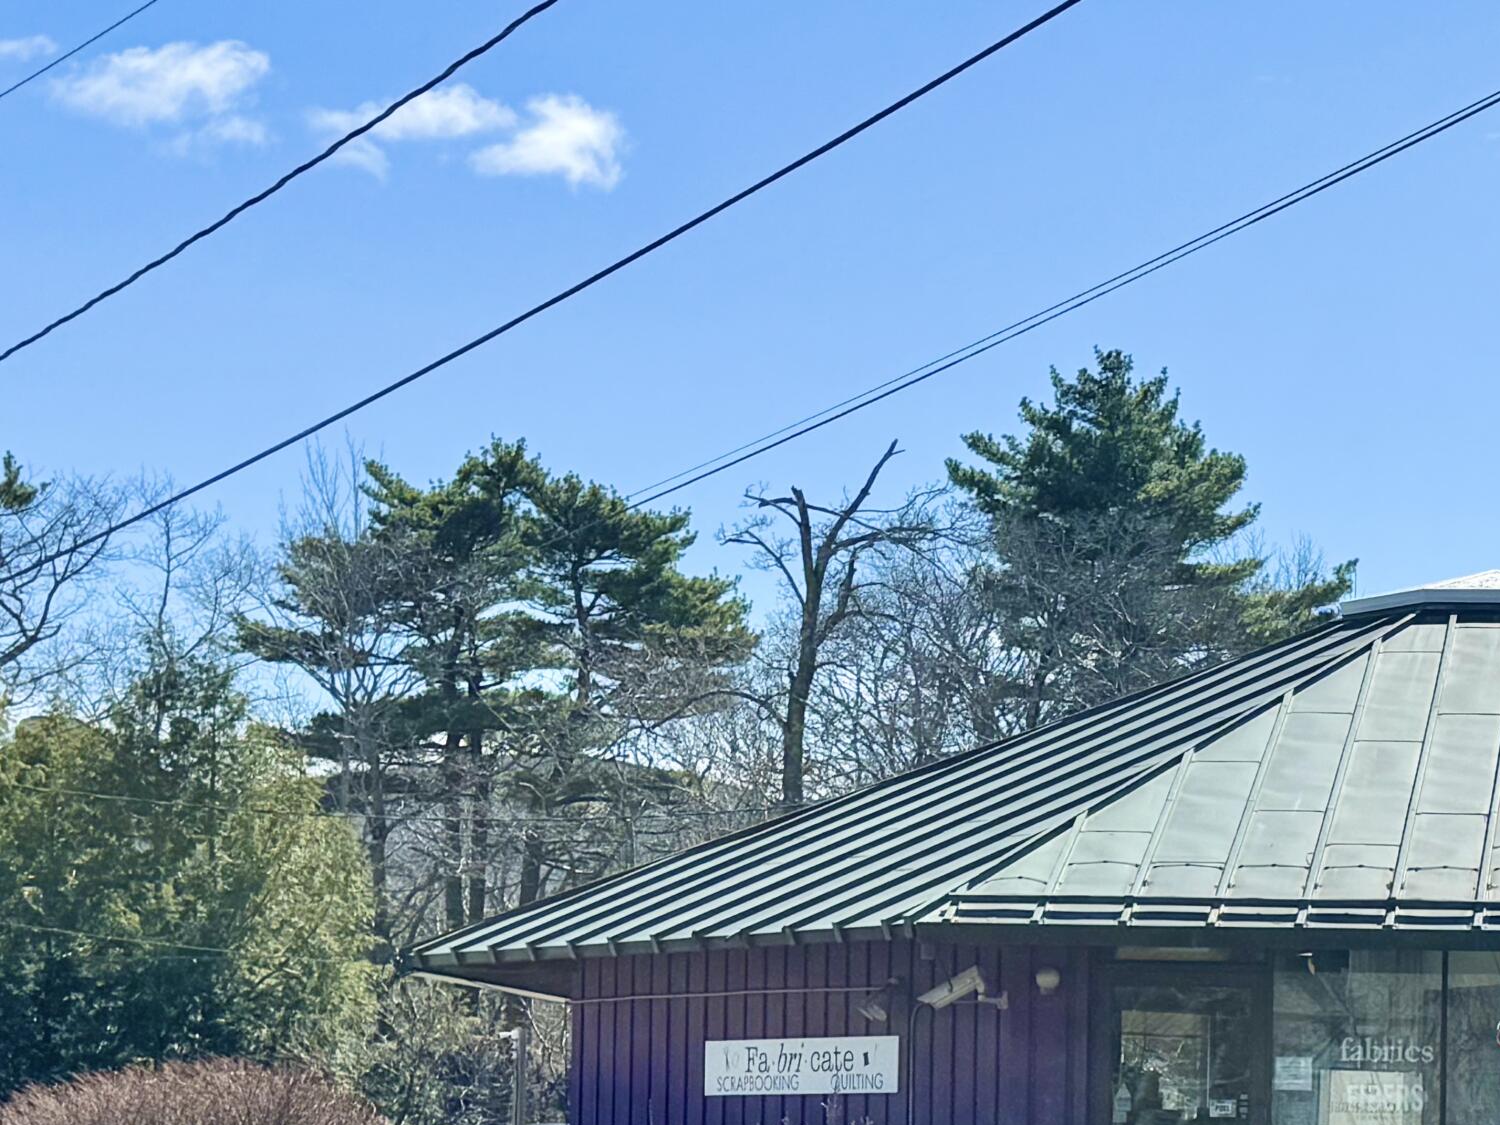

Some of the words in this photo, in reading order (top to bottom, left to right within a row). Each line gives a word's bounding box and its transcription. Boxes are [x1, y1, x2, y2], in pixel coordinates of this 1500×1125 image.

[1340, 1036, 1434, 1064] fabrics
[716, 1074, 800, 1092] SCRAPBOOKING
[830, 1073, 884, 1092] QUILTING
